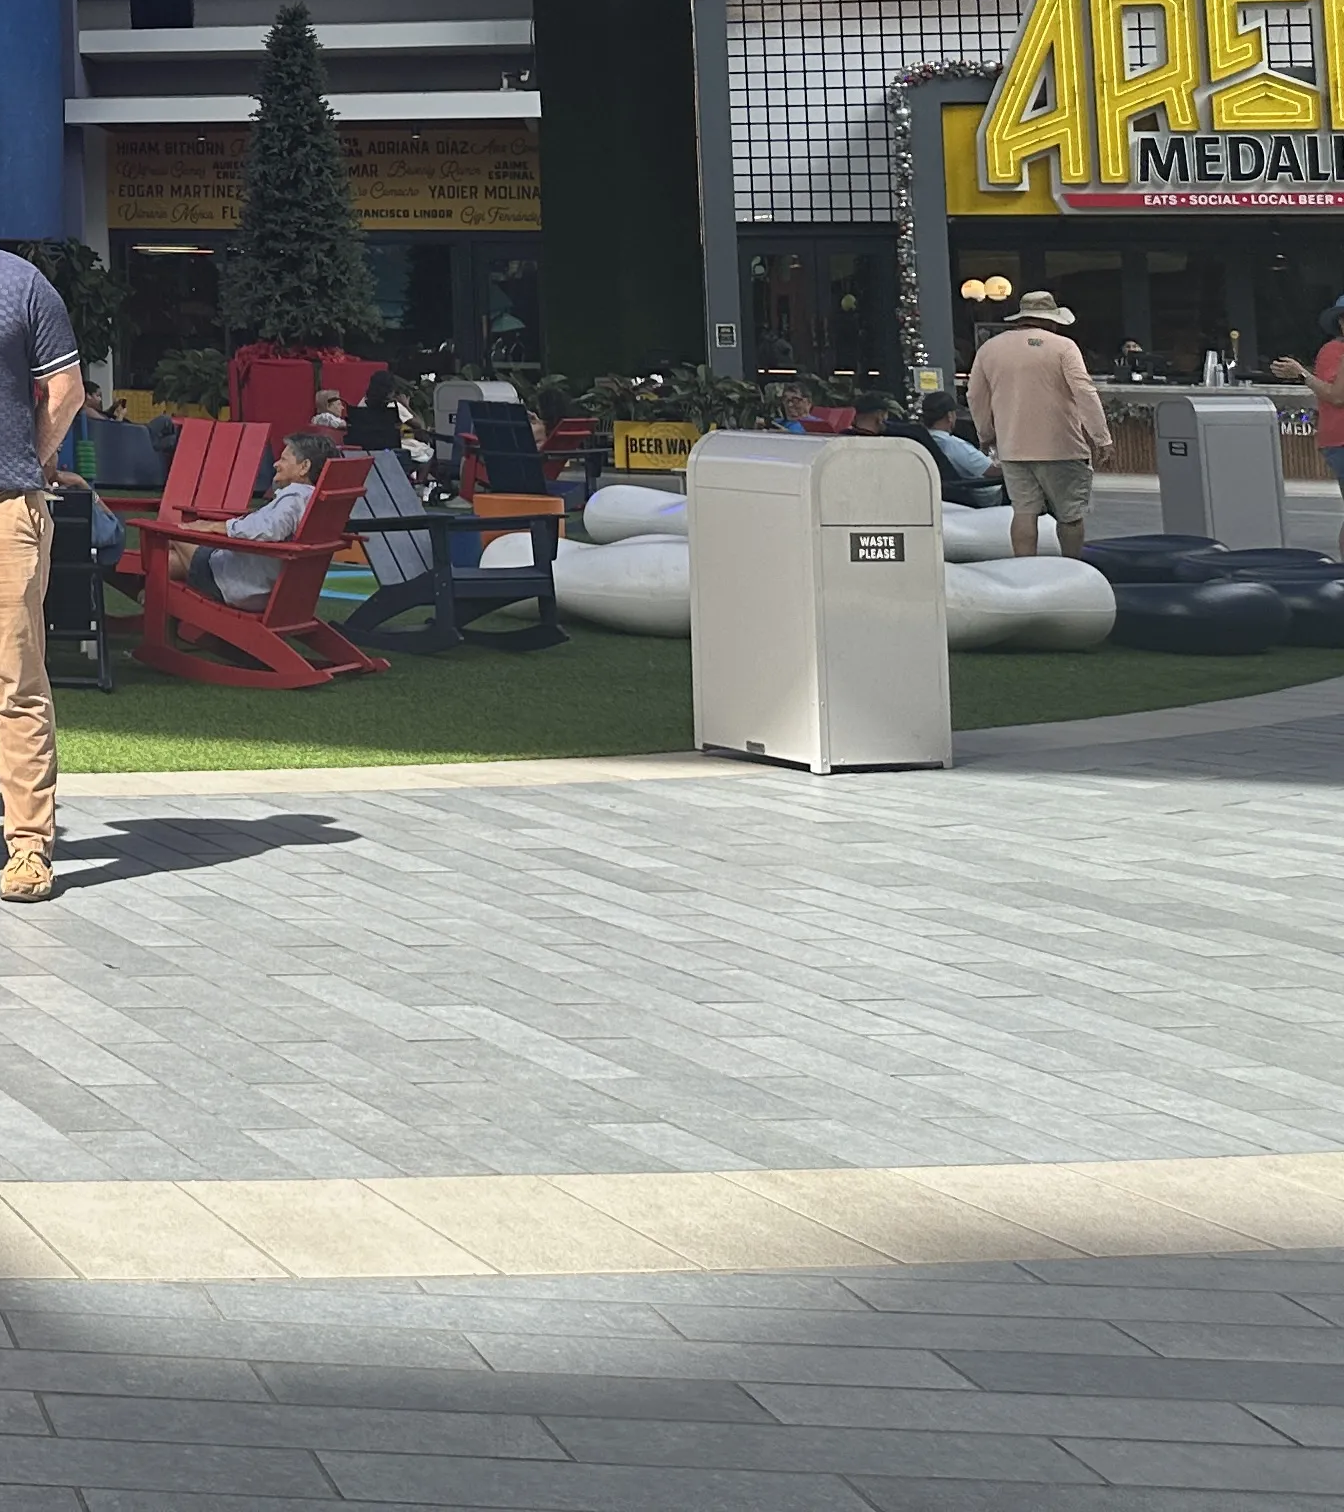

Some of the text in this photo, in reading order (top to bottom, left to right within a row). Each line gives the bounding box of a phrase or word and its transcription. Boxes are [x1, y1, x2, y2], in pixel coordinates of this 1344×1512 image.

[367, 140, 430, 155] ADRIANA
[118, 184, 164, 198] EDGAR
[428, 184, 541, 199] YADIER MOLINA
[1144, 194, 1335, 206] EATS SOCIAL LOCAL BEER
[413, 209, 453, 219] LINDOR
[1281, 421, 1317, 436] MED
[629, 437, 663, 455] BEER
[859, 536, 895, 547] WASTE
[858, 548, 896, 559] PLEASE
